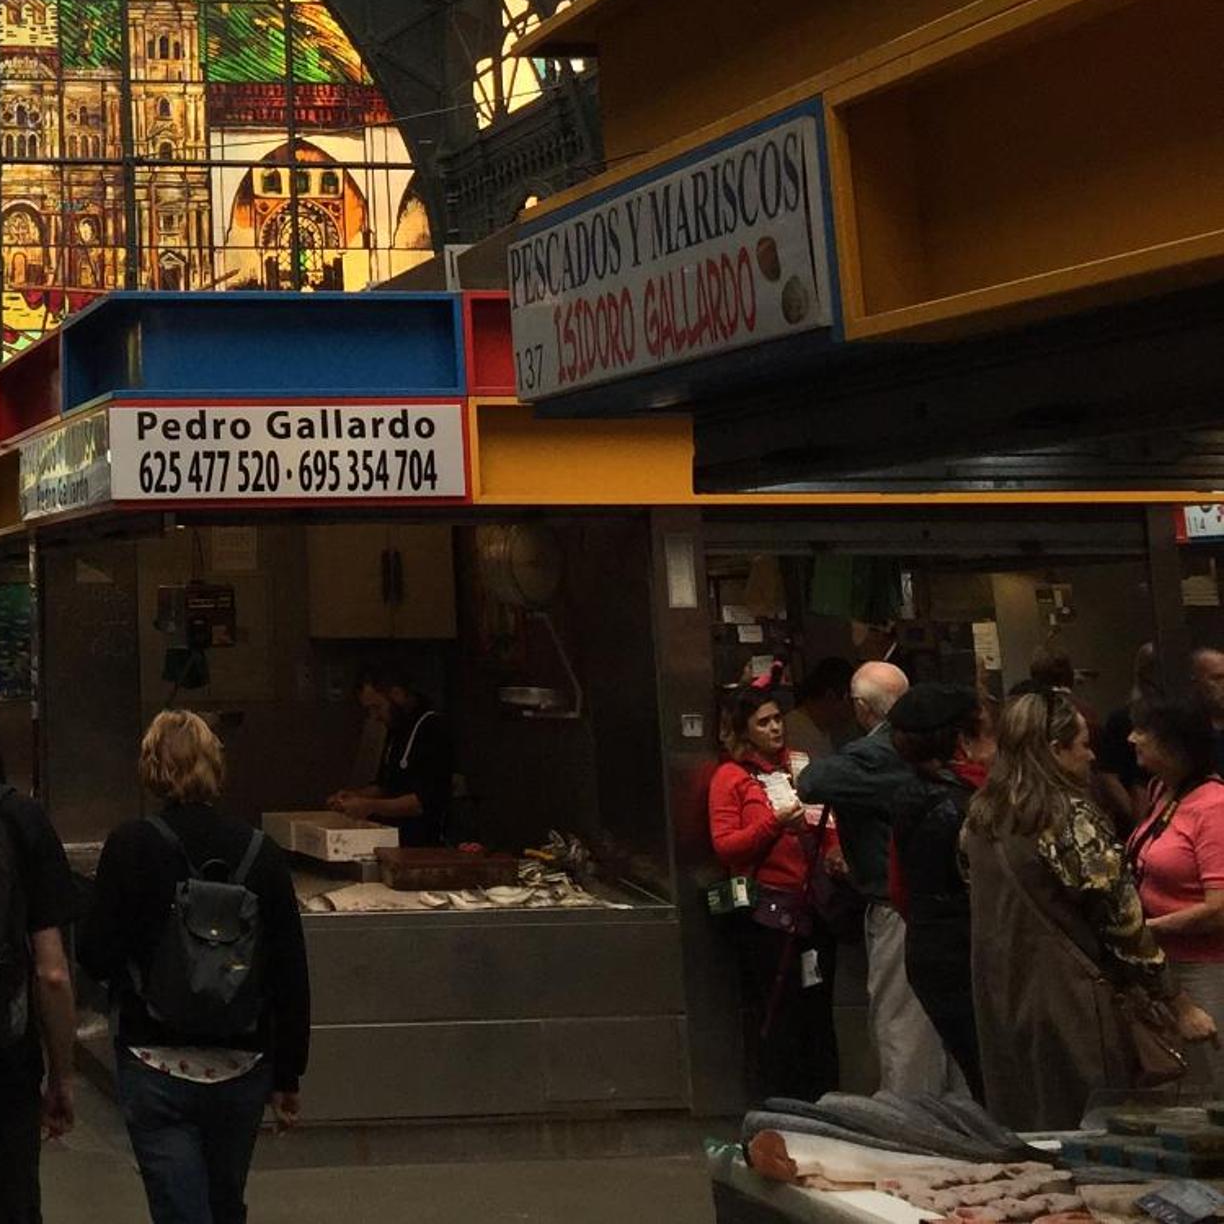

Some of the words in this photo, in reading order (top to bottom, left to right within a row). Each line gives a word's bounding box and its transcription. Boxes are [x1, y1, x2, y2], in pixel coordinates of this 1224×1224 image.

[511, 213, 623, 309] PESCADOS
[627, 197, 644, 267] Y
[649, 133, 800, 256] MARISCOS
[554, 284, 637, 384] ISIDORO
[643, 246, 758, 361] GALLARDO
[516, 343, 544, 391] 137
[137, 410, 251, 441] Pedro
[266, 408, 436, 440] Gallardo
[138, 450, 182, 494] 625
[188, 450, 232, 493] 477
[237, 450, 281, 493] 520
[299, 450, 340, 492] 695
[347, 449, 389, 492] 354
[394, 449, 439, 491] 704
